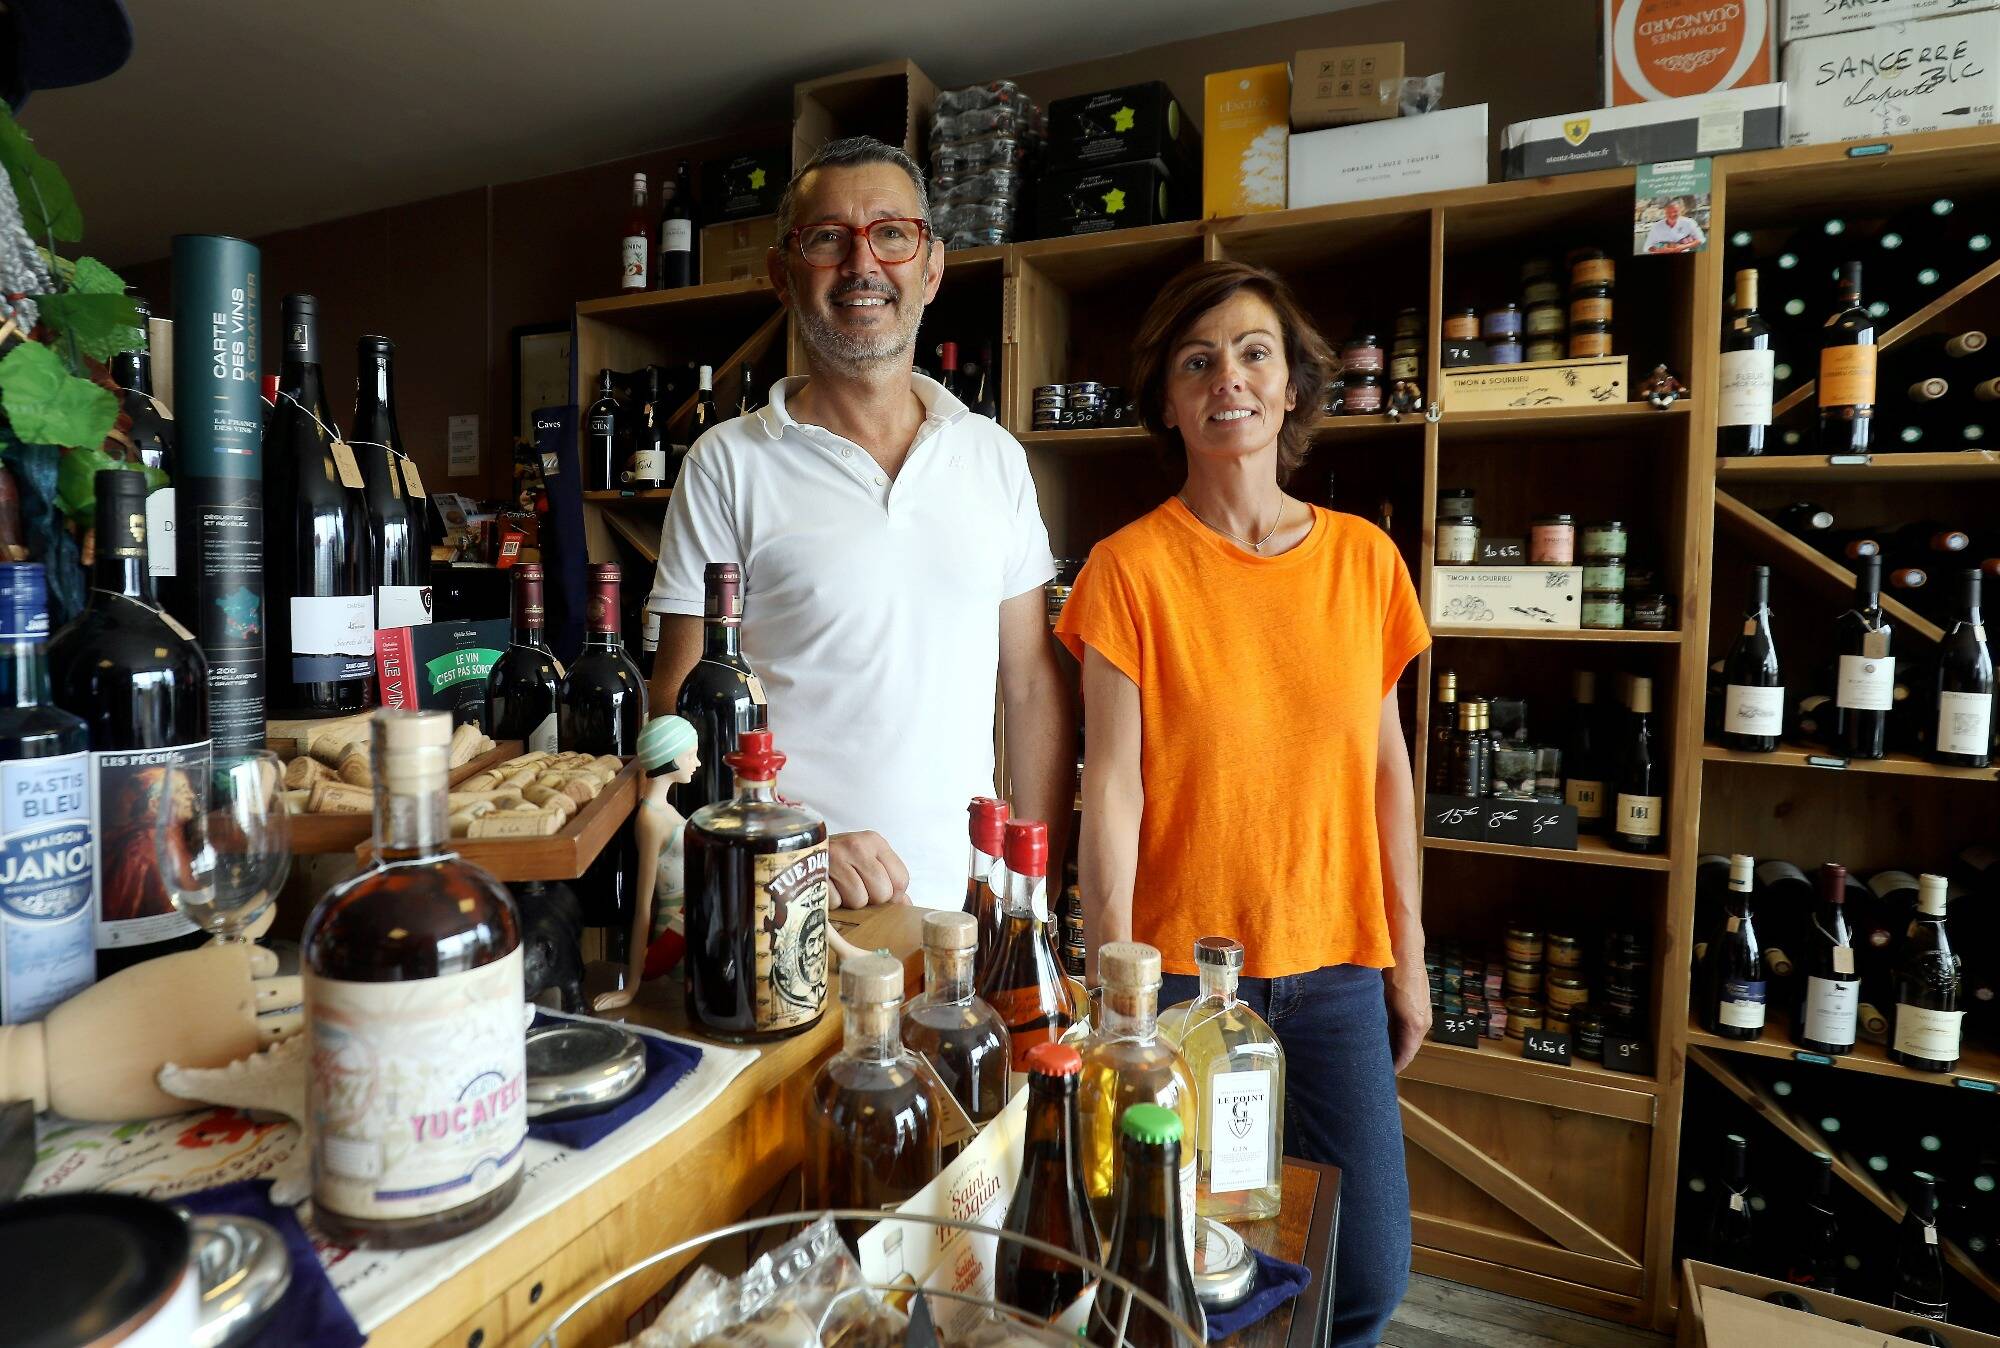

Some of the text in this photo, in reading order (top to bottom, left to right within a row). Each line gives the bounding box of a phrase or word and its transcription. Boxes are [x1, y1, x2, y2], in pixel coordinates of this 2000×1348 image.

[1639, 3, 1741, 36] QUANCARD
[1651, 20, 1728, 46] DOMAINES
[1815, 40, 1969, 86] SANCERRE
[247, 272, 256, 363] GRATTER
[213, 312, 228, 379] CARTE
[232, 287, 246, 381] DES VINS
[227, 419, 257, 428] FRANCE
[537, 420, 562, 429] Caves
[384, 658, 401, 678] LE
[456, 652, 479, 666] LE VIN
[216, 667, 238, 675] 200
[436, 668, 456, 685] C'EST
[457, 665, 471, 678] PAS
[101, 756, 128, 767] LES
[17, 772, 83, 796] PASTIS
[23, 791, 82, 818] BLEU
[20, 830, 84, 853] MAISON
[1217, 1094, 1265, 1105] LE POINT
[952, 1170, 985, 1213] Saint
